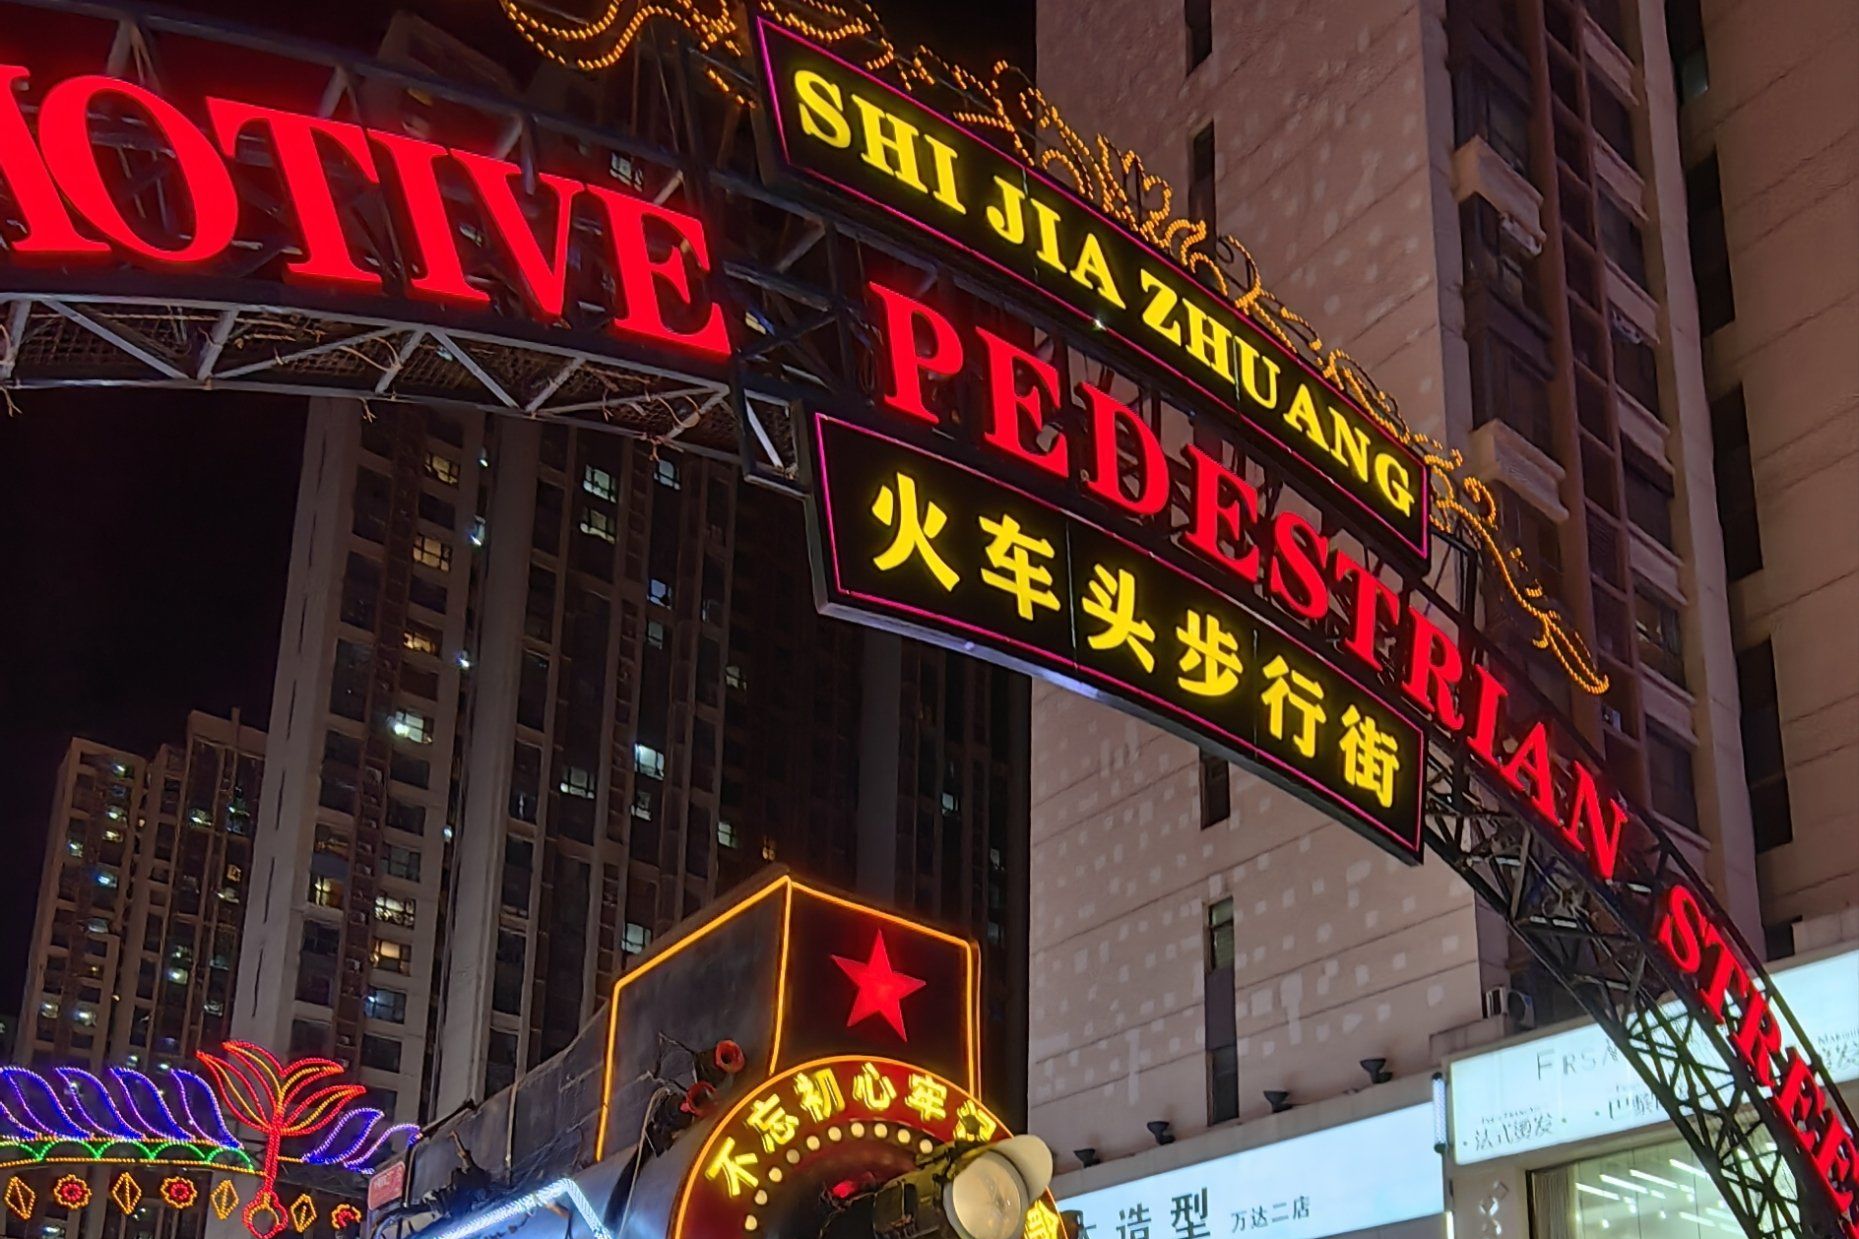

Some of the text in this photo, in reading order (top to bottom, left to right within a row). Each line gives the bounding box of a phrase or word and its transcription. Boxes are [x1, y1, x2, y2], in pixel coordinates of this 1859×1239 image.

[794, 69, 1416, 517] SHI JIA ZHUANG
[868, 281, 1628, 879] PEDESTRIAN
[871, 474, 1401, 808] 火车头步行街
[1230, 1195, 1311, 1234] 万达二店
